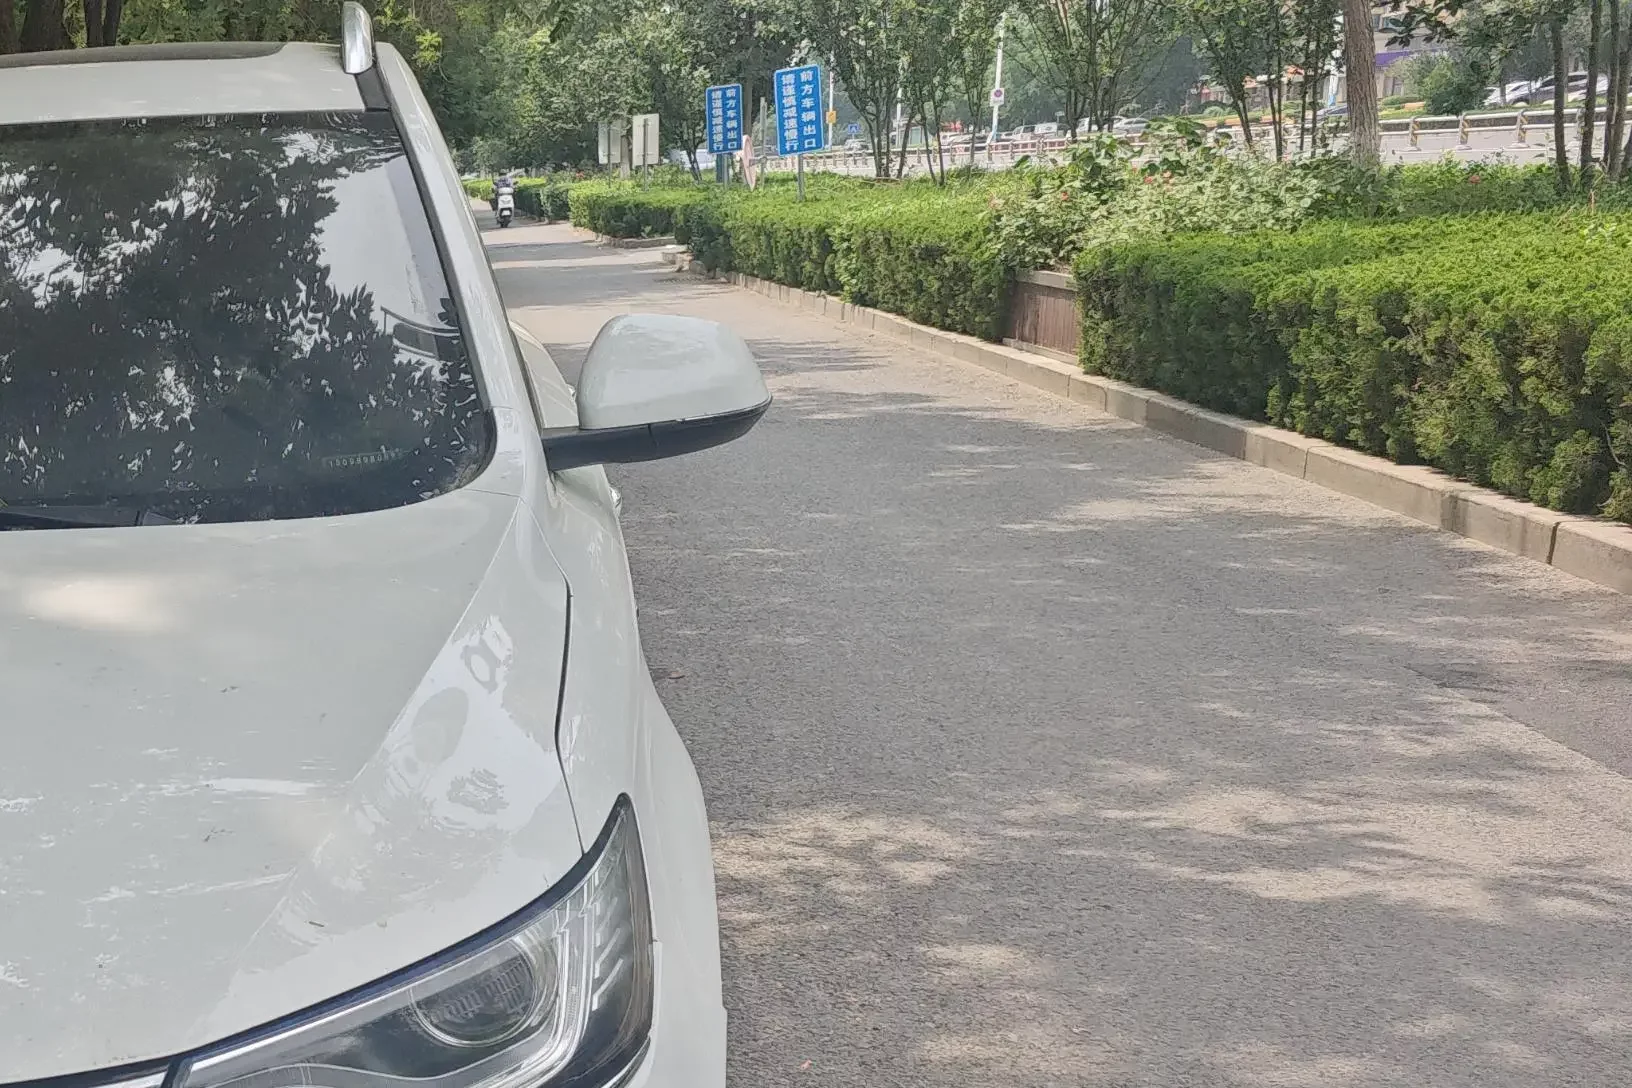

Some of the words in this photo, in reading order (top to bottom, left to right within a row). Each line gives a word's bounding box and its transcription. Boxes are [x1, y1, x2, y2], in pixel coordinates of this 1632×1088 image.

[781, 73, 799, 152] 请谨慎减速慢行
[800, 70, 817, 149] 前方车辆出口
